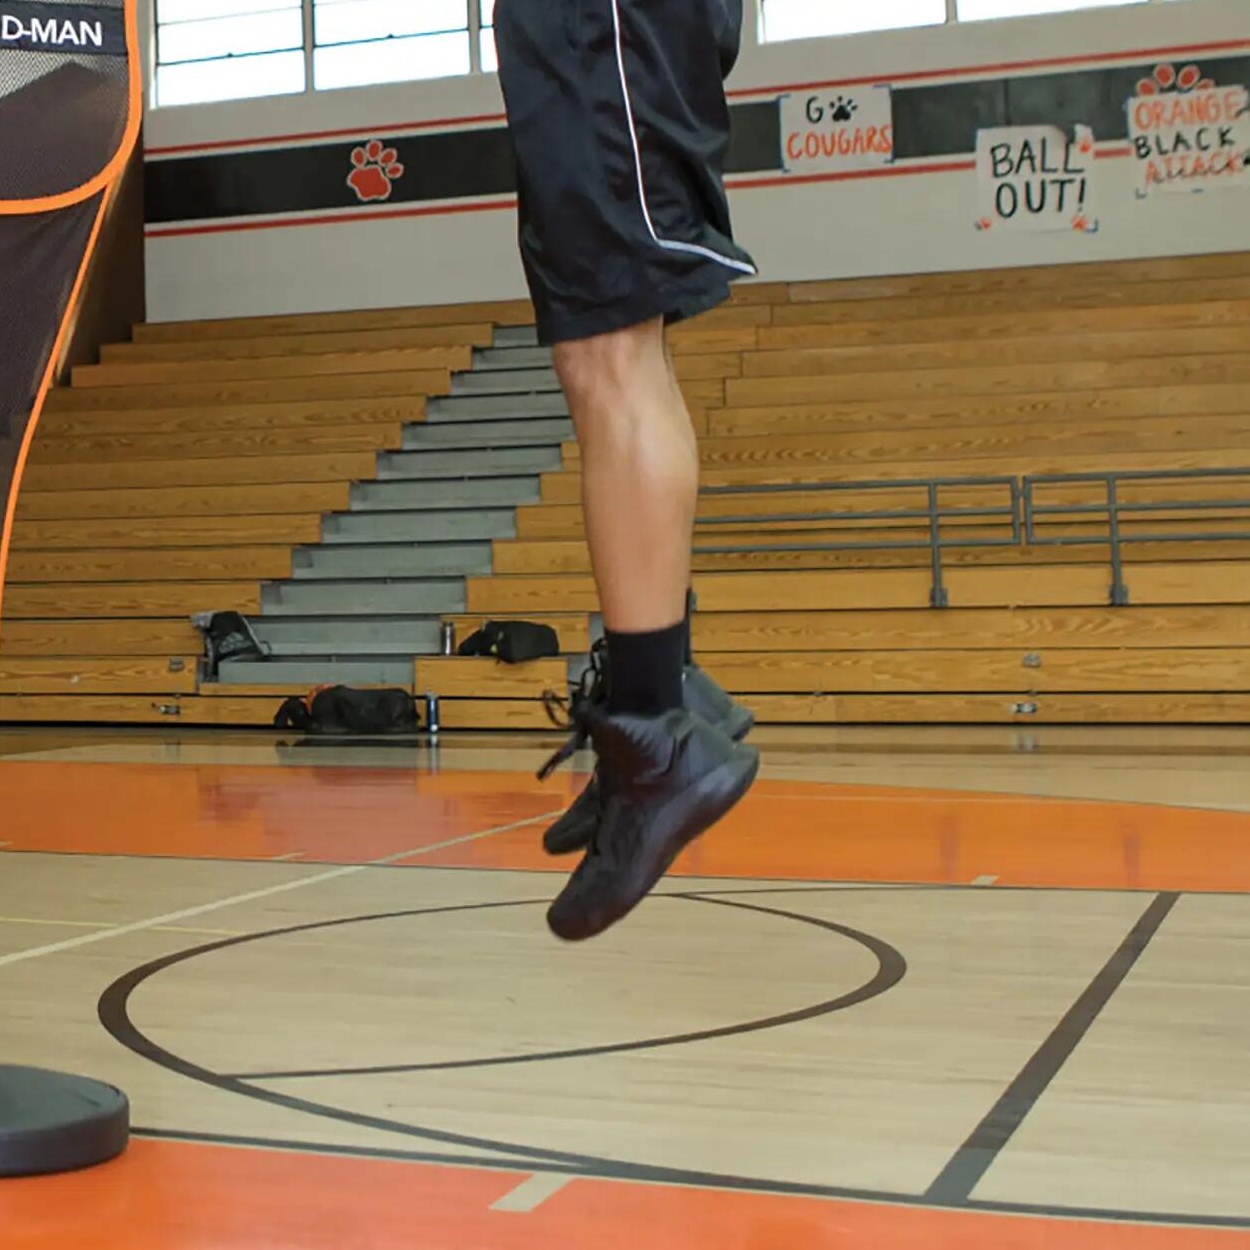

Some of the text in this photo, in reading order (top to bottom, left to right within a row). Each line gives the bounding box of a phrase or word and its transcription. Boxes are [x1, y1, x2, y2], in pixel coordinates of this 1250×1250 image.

[1, 15, 102, 46] D-MAN
[1134, 90, 1240, 130] ORANGE
[786, 125, 892, 160] COUGARS
[990, 137, 1085, 178] BALL
[1134, 127, 1235, 160] BLACK
[1144, 152, 1240, 187] ATTACK
[996, 178, 1086, 216] OUT!
